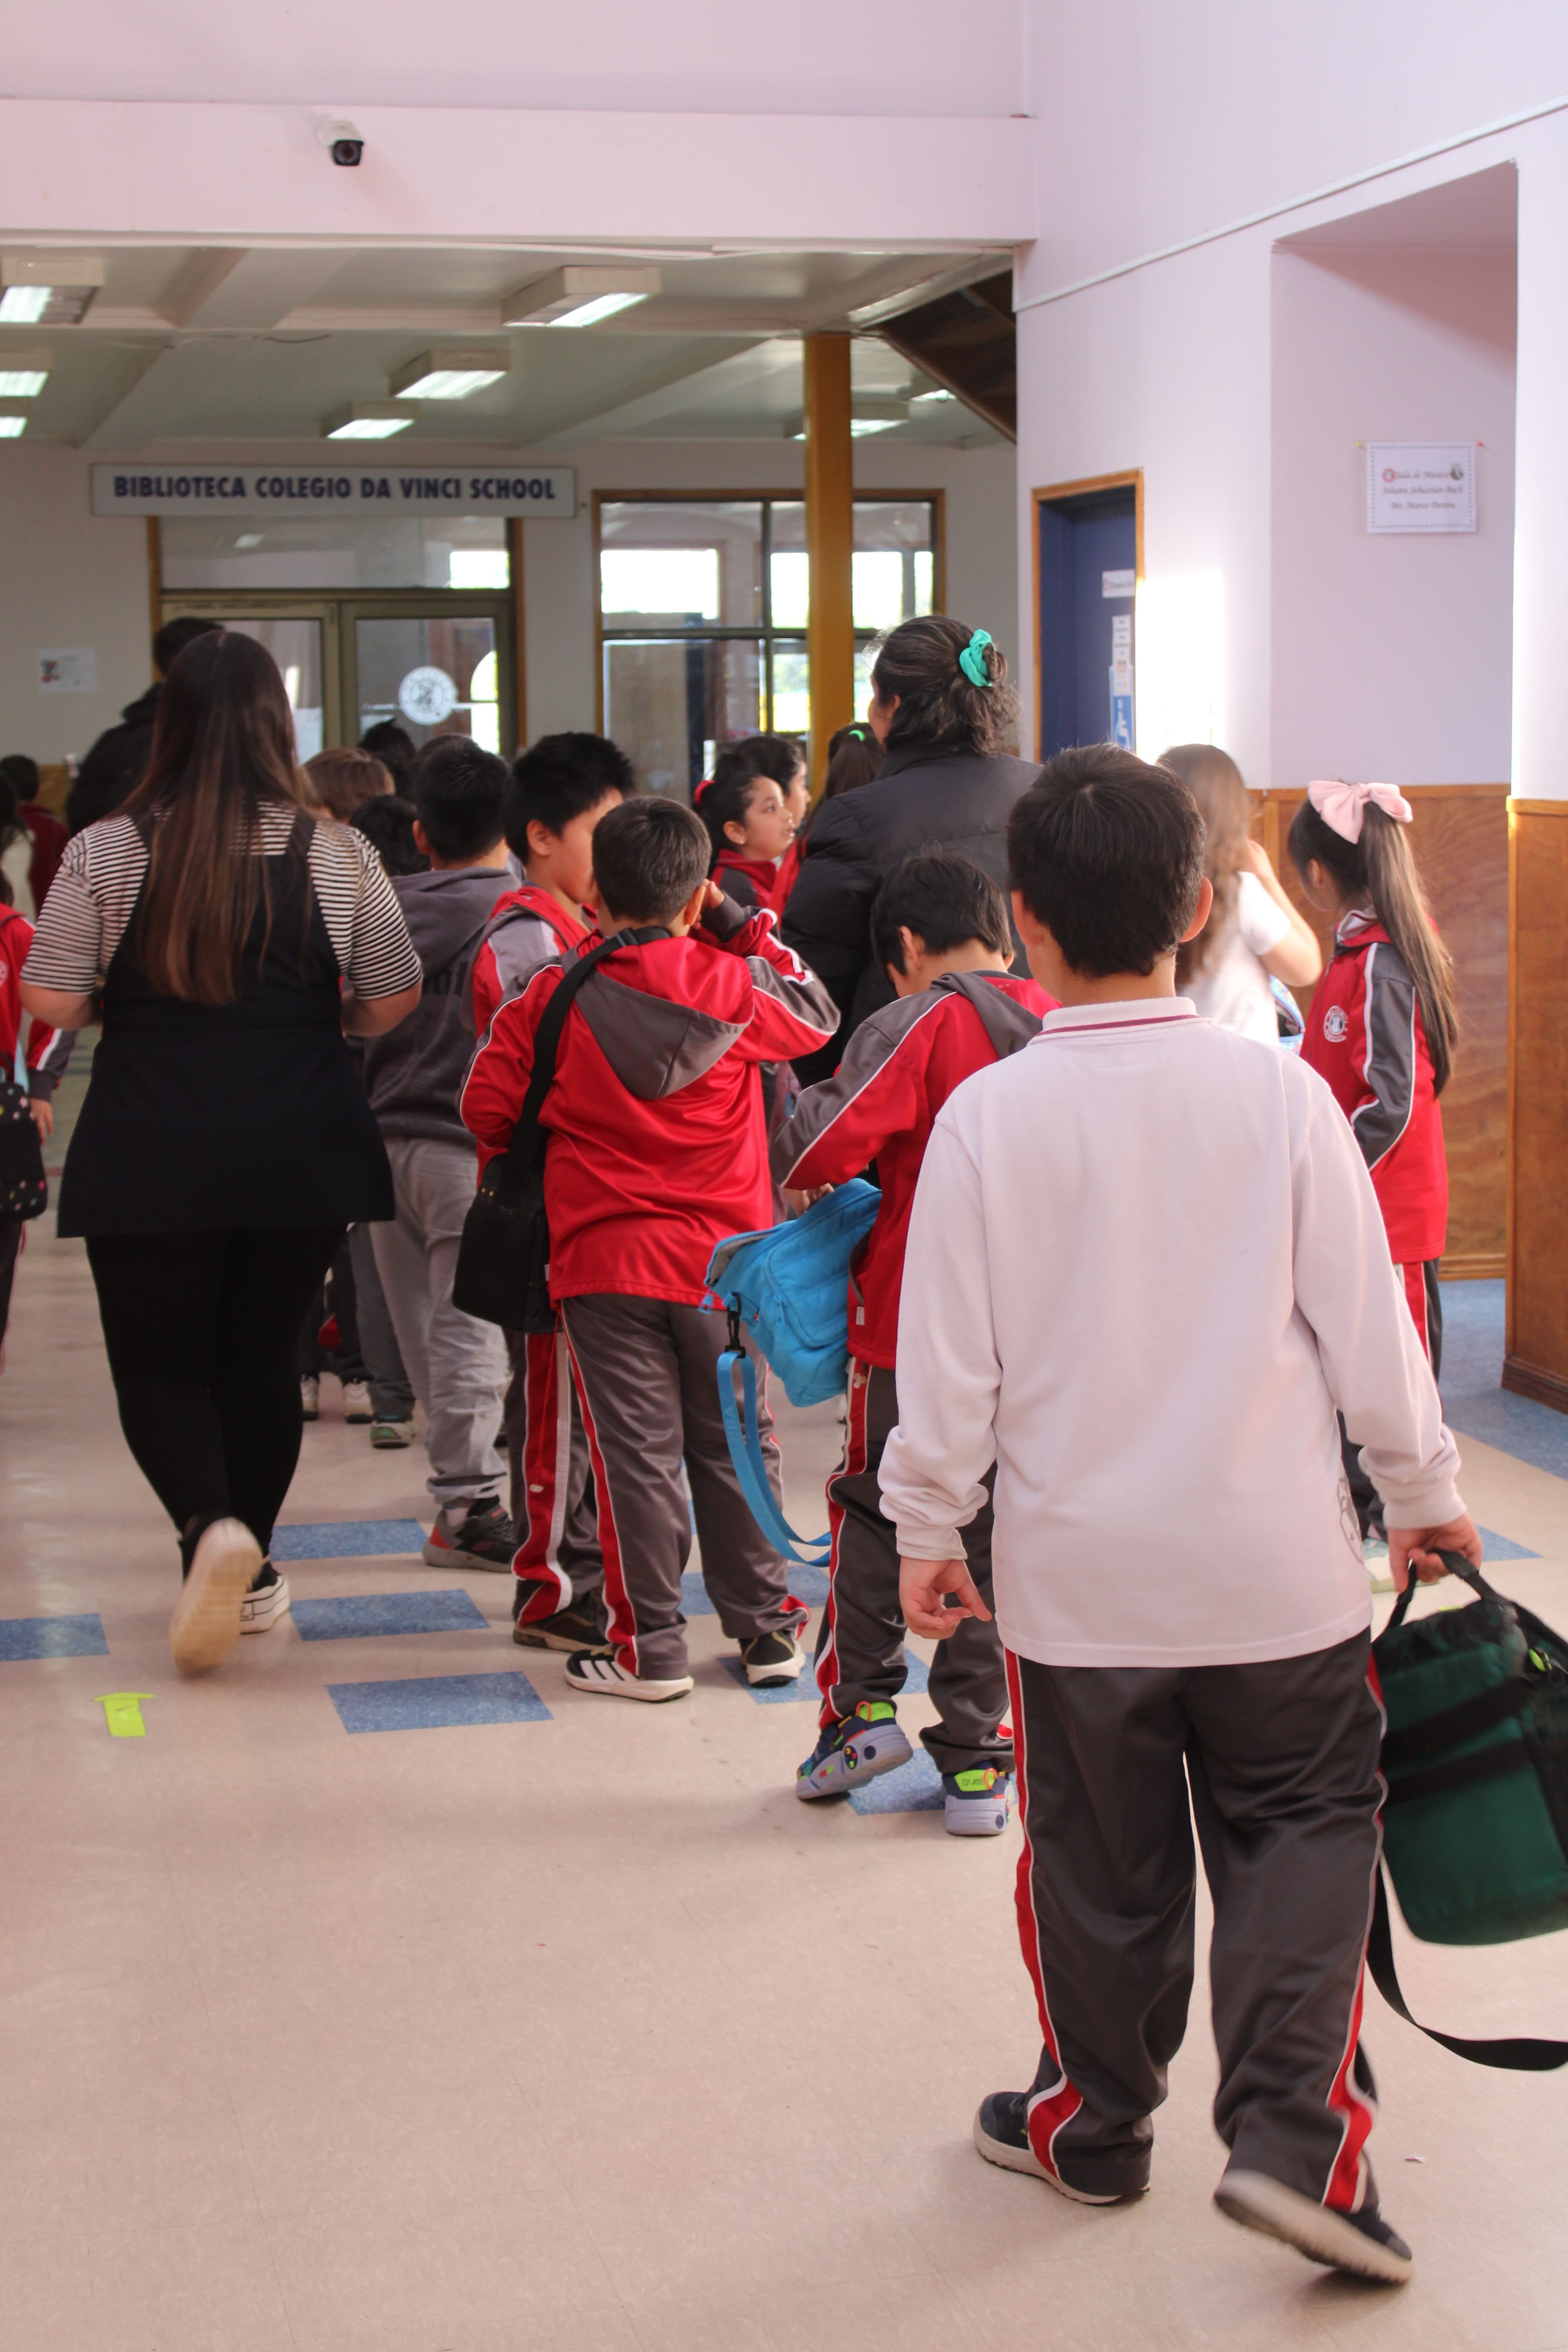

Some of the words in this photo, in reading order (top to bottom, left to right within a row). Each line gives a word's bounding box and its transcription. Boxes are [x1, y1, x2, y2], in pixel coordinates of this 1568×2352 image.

[114, 476, 247, 498] BIBLIOTECA
[255, 477, 351, 498] COLEGIO
[360, 477, 391, 498] DA
[399, 478, 461, 498] VINCI
[470, 478, 555, 499] SCHOOL
